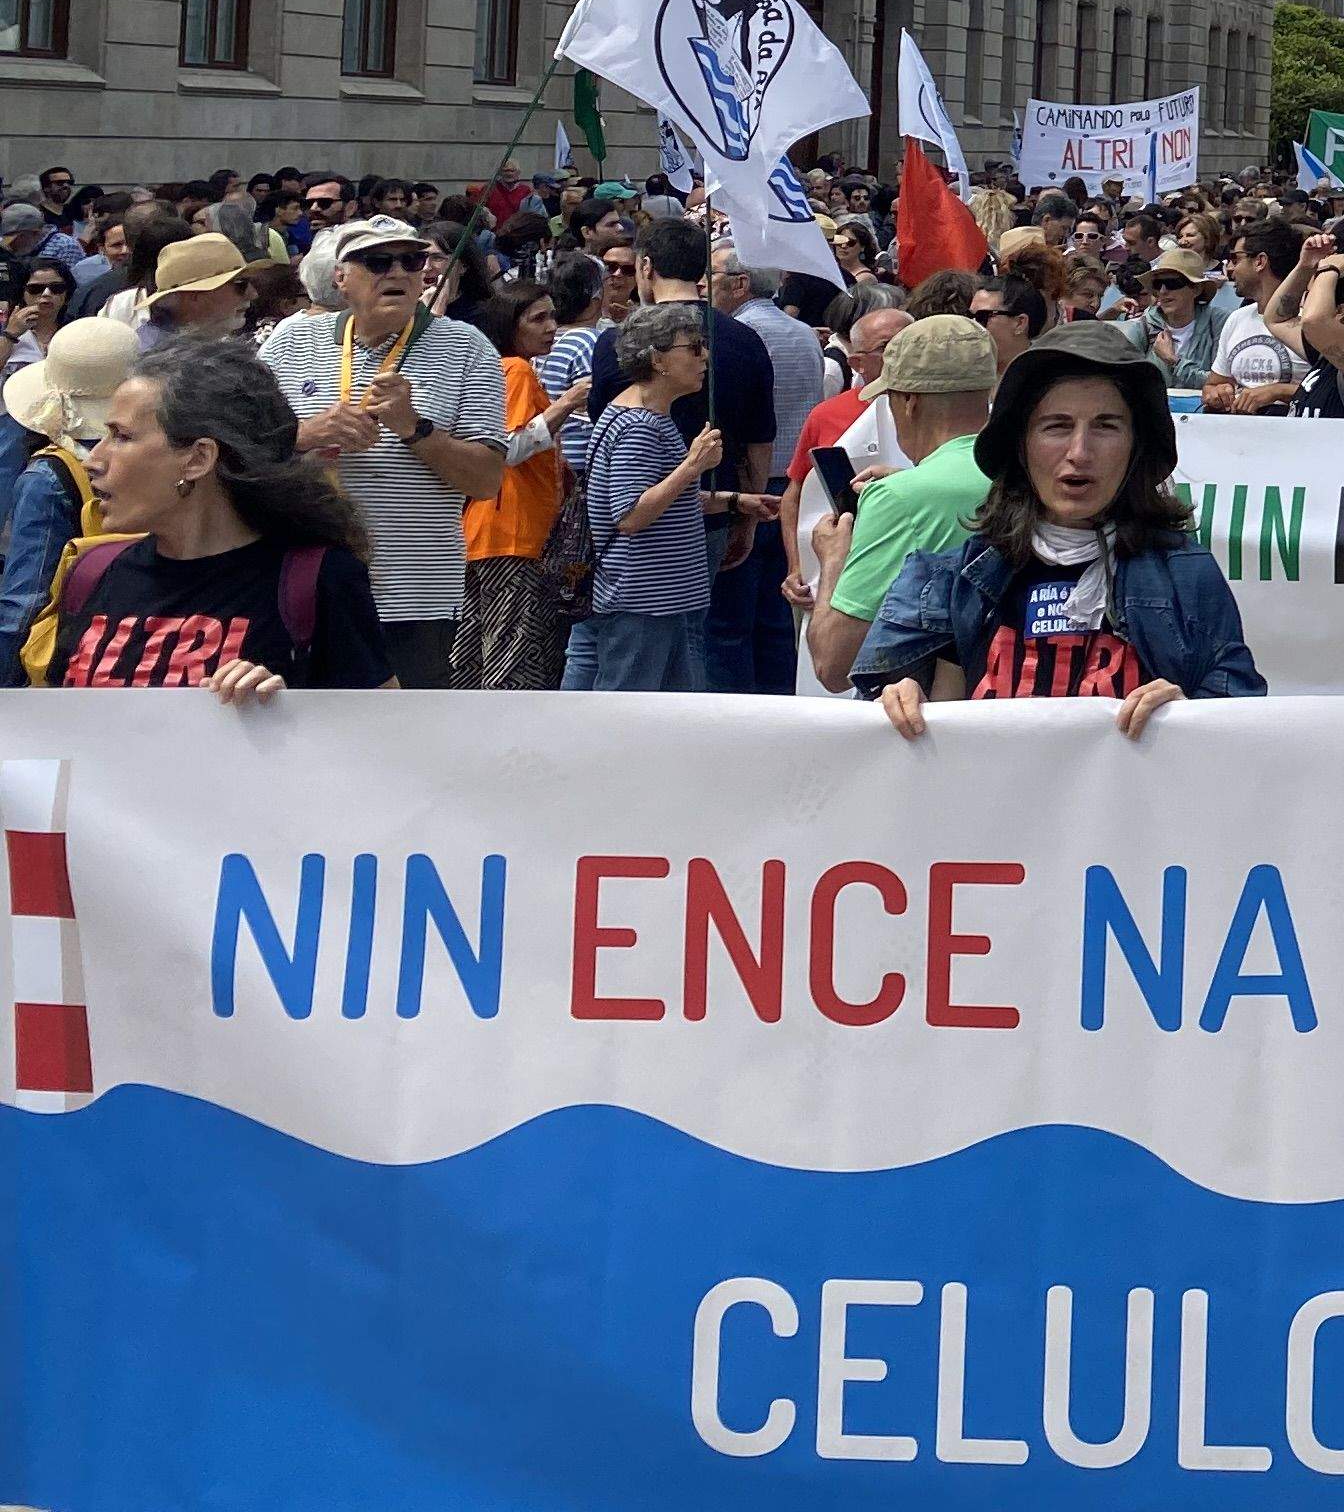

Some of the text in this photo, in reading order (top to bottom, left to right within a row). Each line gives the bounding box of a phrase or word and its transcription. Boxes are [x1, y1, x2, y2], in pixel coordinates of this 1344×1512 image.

[758, 30, 784, 64] da
[1130, 110, 1151, 123] POLO
[1158, 94, 1195, 123] FUTURO
[1061, 127, 1193, 171] ALTRI NON
[1030, 589, 1038, 603] A
[1039, 584, 1058, 601] RÍA
[63, 614, 249, 688] ALTRI
[971, 625, 1140, 699] ALTRI
[211, 853, 507, 1020] NIN
[570, 855, 1025, 1029] ENCE
[1080, 864, 1318, 1032] NA
